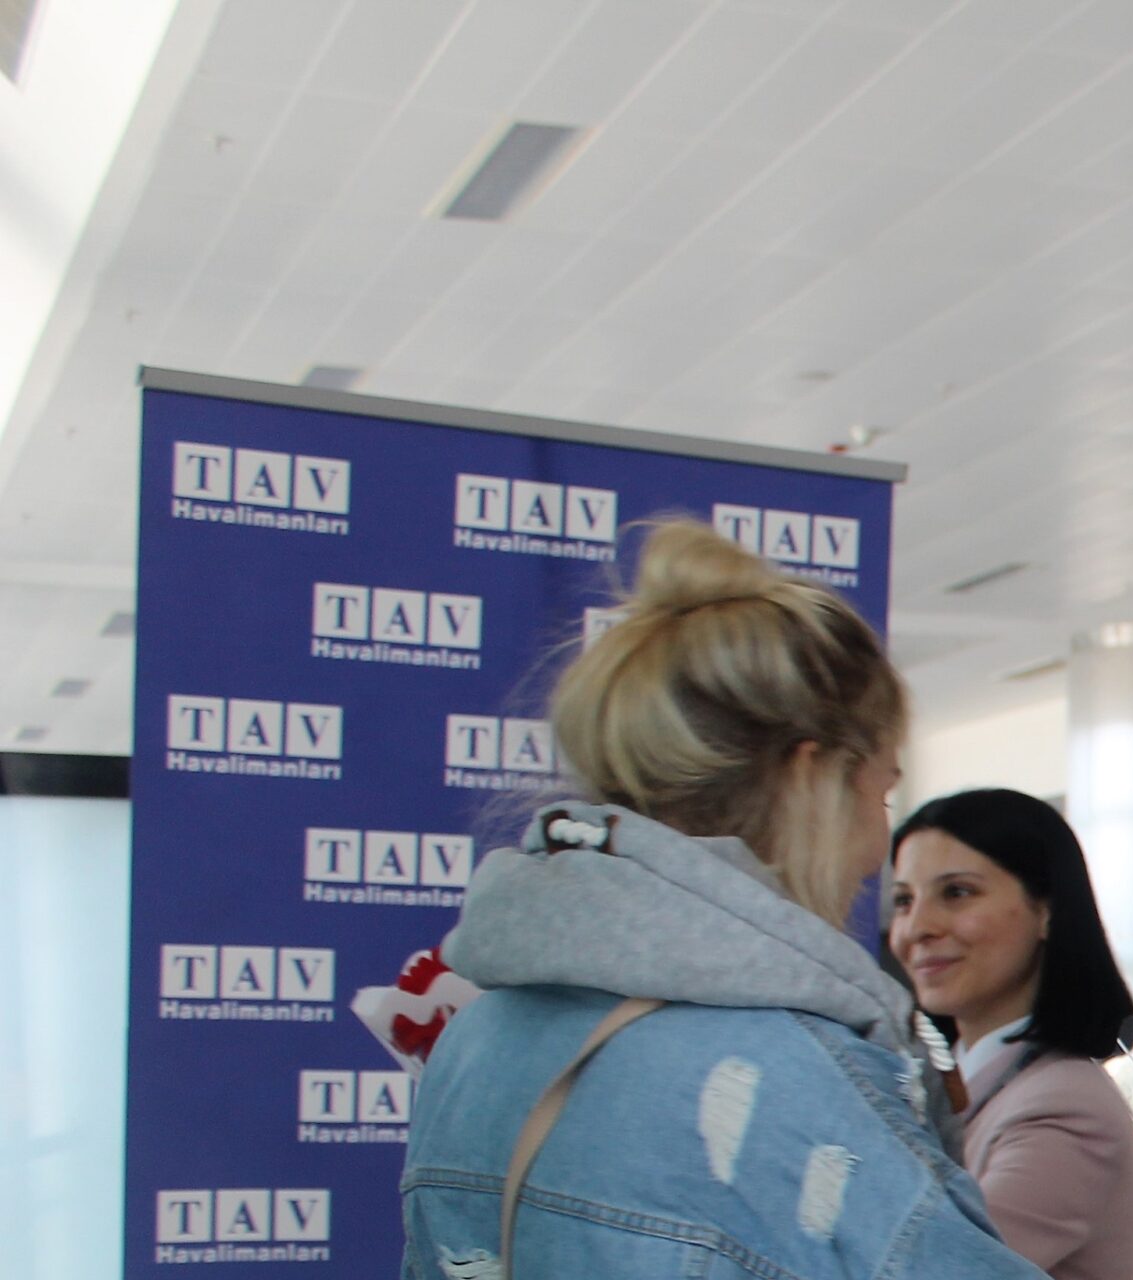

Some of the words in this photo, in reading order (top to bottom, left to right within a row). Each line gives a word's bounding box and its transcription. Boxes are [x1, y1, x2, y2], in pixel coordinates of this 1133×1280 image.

[186, 453, 339, 501] TAV
[172, 497, 349, 535] Havalimanları
[467, 485, 607, 531] TAV
[454, 528, 616, 562] Havalimanları
[722, 515, 850, 556] TAV
[325, 593, 471, 638] TAV
[311, 637, 481, 670] Havalimanları
[180, 706, 332, 748] TAV
[457, 725, 543, 764] TA
[166, 751, 342, 780] Havalimanları
[317, 839, 463, 878] TAV
[304, 882, 465, 908] Havalimanlar
[173, 955, 324, 992] TAV
[160, 1000, 334, 1022] Havalimanları
[311, 1081, 400, 1116] TA
[298, 1124, 409, 1143] Havalima
[168, 1198, 319, 1235] TAV
[156, 1243, 330, 1264] Havalimanları
